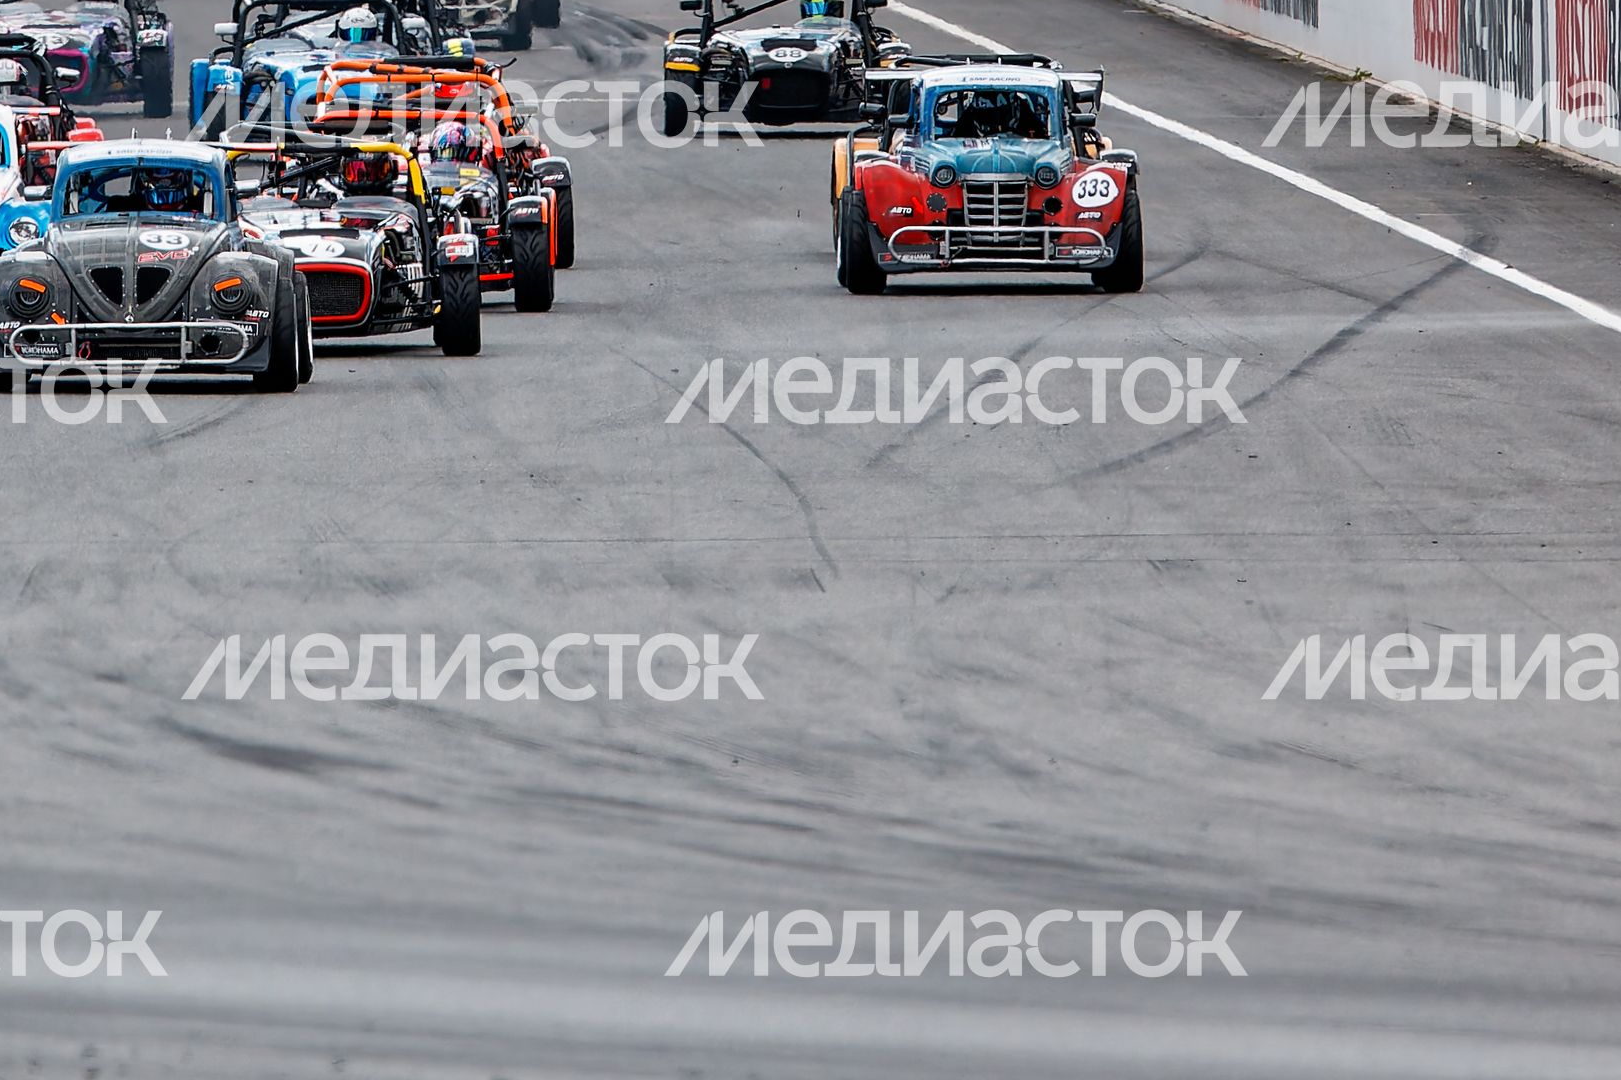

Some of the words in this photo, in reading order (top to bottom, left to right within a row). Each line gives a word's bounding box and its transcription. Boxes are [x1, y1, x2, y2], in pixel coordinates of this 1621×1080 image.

[775, 49, 802, 58] 88
[1078, 178, 1110, 199] 333
[146, 234, 183, 245] 33
[21, 346, 59, 355] YOKOHAMA
